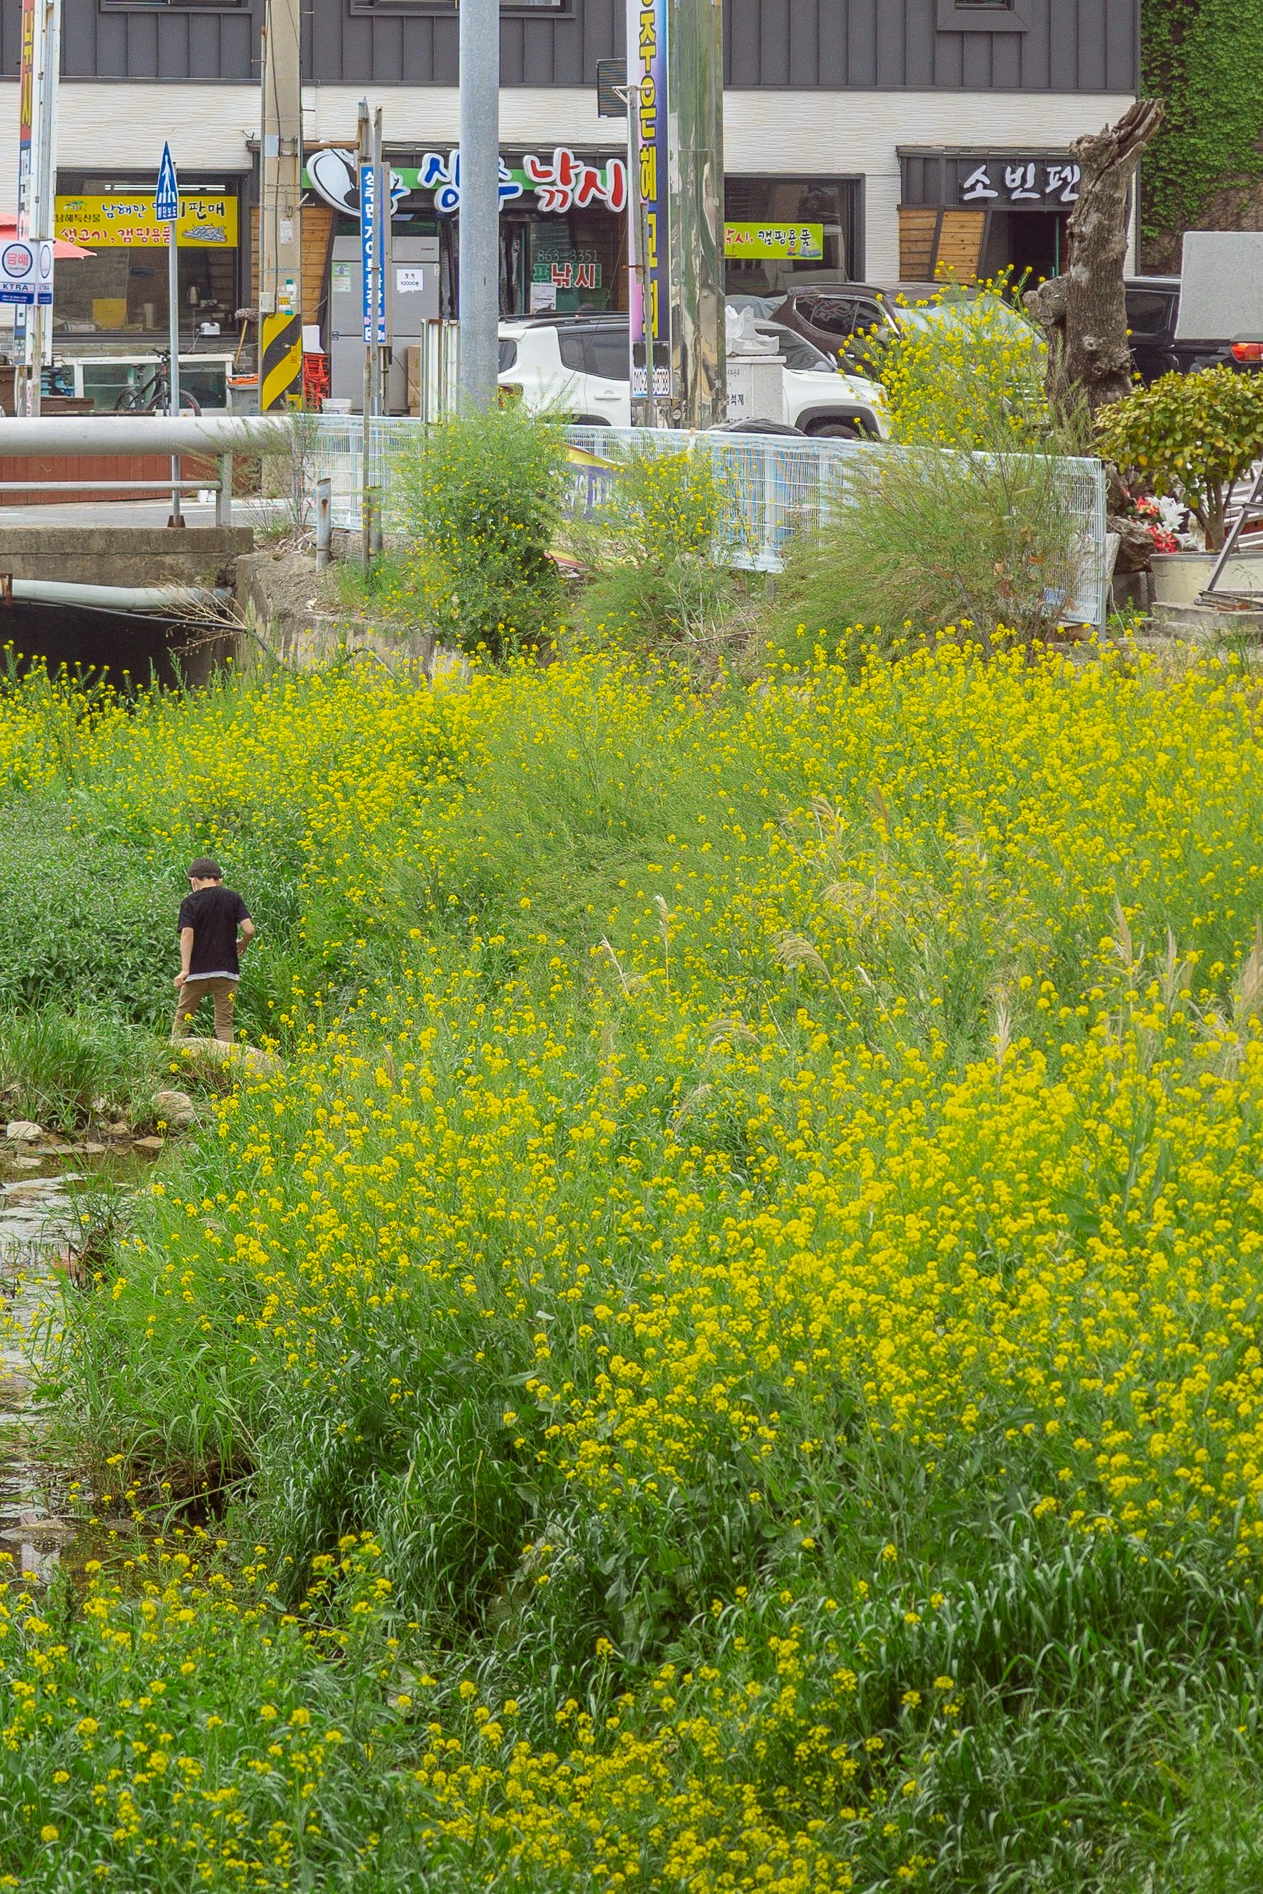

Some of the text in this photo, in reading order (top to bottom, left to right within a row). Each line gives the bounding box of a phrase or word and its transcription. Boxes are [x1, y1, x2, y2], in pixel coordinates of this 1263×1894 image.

[527, 149, 625, 210] 낚시
[102, 202, 148, 219] 남해안
[117, 226, 171, 244] 캠핑용품
[757, 228, 812, 247] 캠핑용품
[7, 252, 29, 266] 담배
[537, 249, 598, 263] 863-3351
[551, 262, 596, 289] 낚시
[2, 283, 29, 291] KTRA
